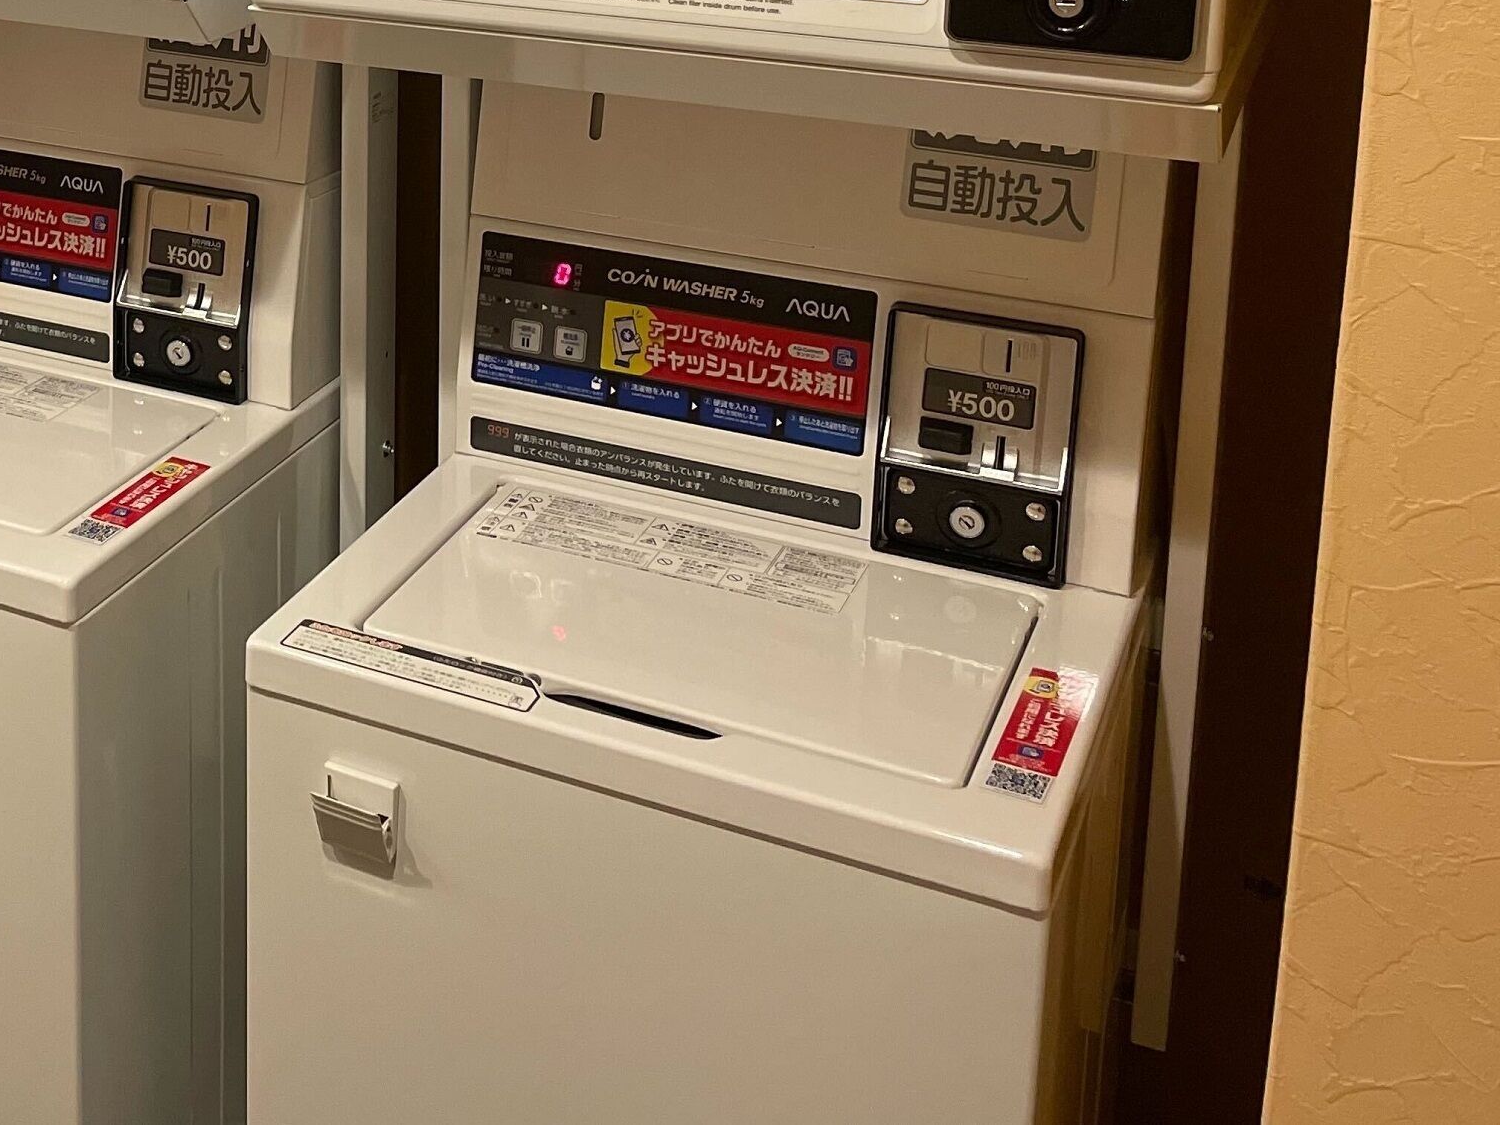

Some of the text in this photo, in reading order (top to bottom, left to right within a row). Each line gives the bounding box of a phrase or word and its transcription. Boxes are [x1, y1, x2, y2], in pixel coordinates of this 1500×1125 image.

[144, 59, 261, 115] 自動投入
[60, 175, 104, 194] AQUA
[908, 160, 1086, 232] 自動投入
[167, 243, 212, 270] ¥500
[553, 263, 572, 285] 0
[663, 277, 738, 301] WASHER
[740, 290, 765, 308] 5kg
[785, 298, 850, 322] AQUA
[648, 320, 782, 359] アプリでかんたん
[646, 343, 853, 401] キャッシュレス決済!!
[713, 399, 757, 414] 硬貨を入れる
[947, 389, 1015, 422] ¥500
[487, 425, 510, 439] 999
